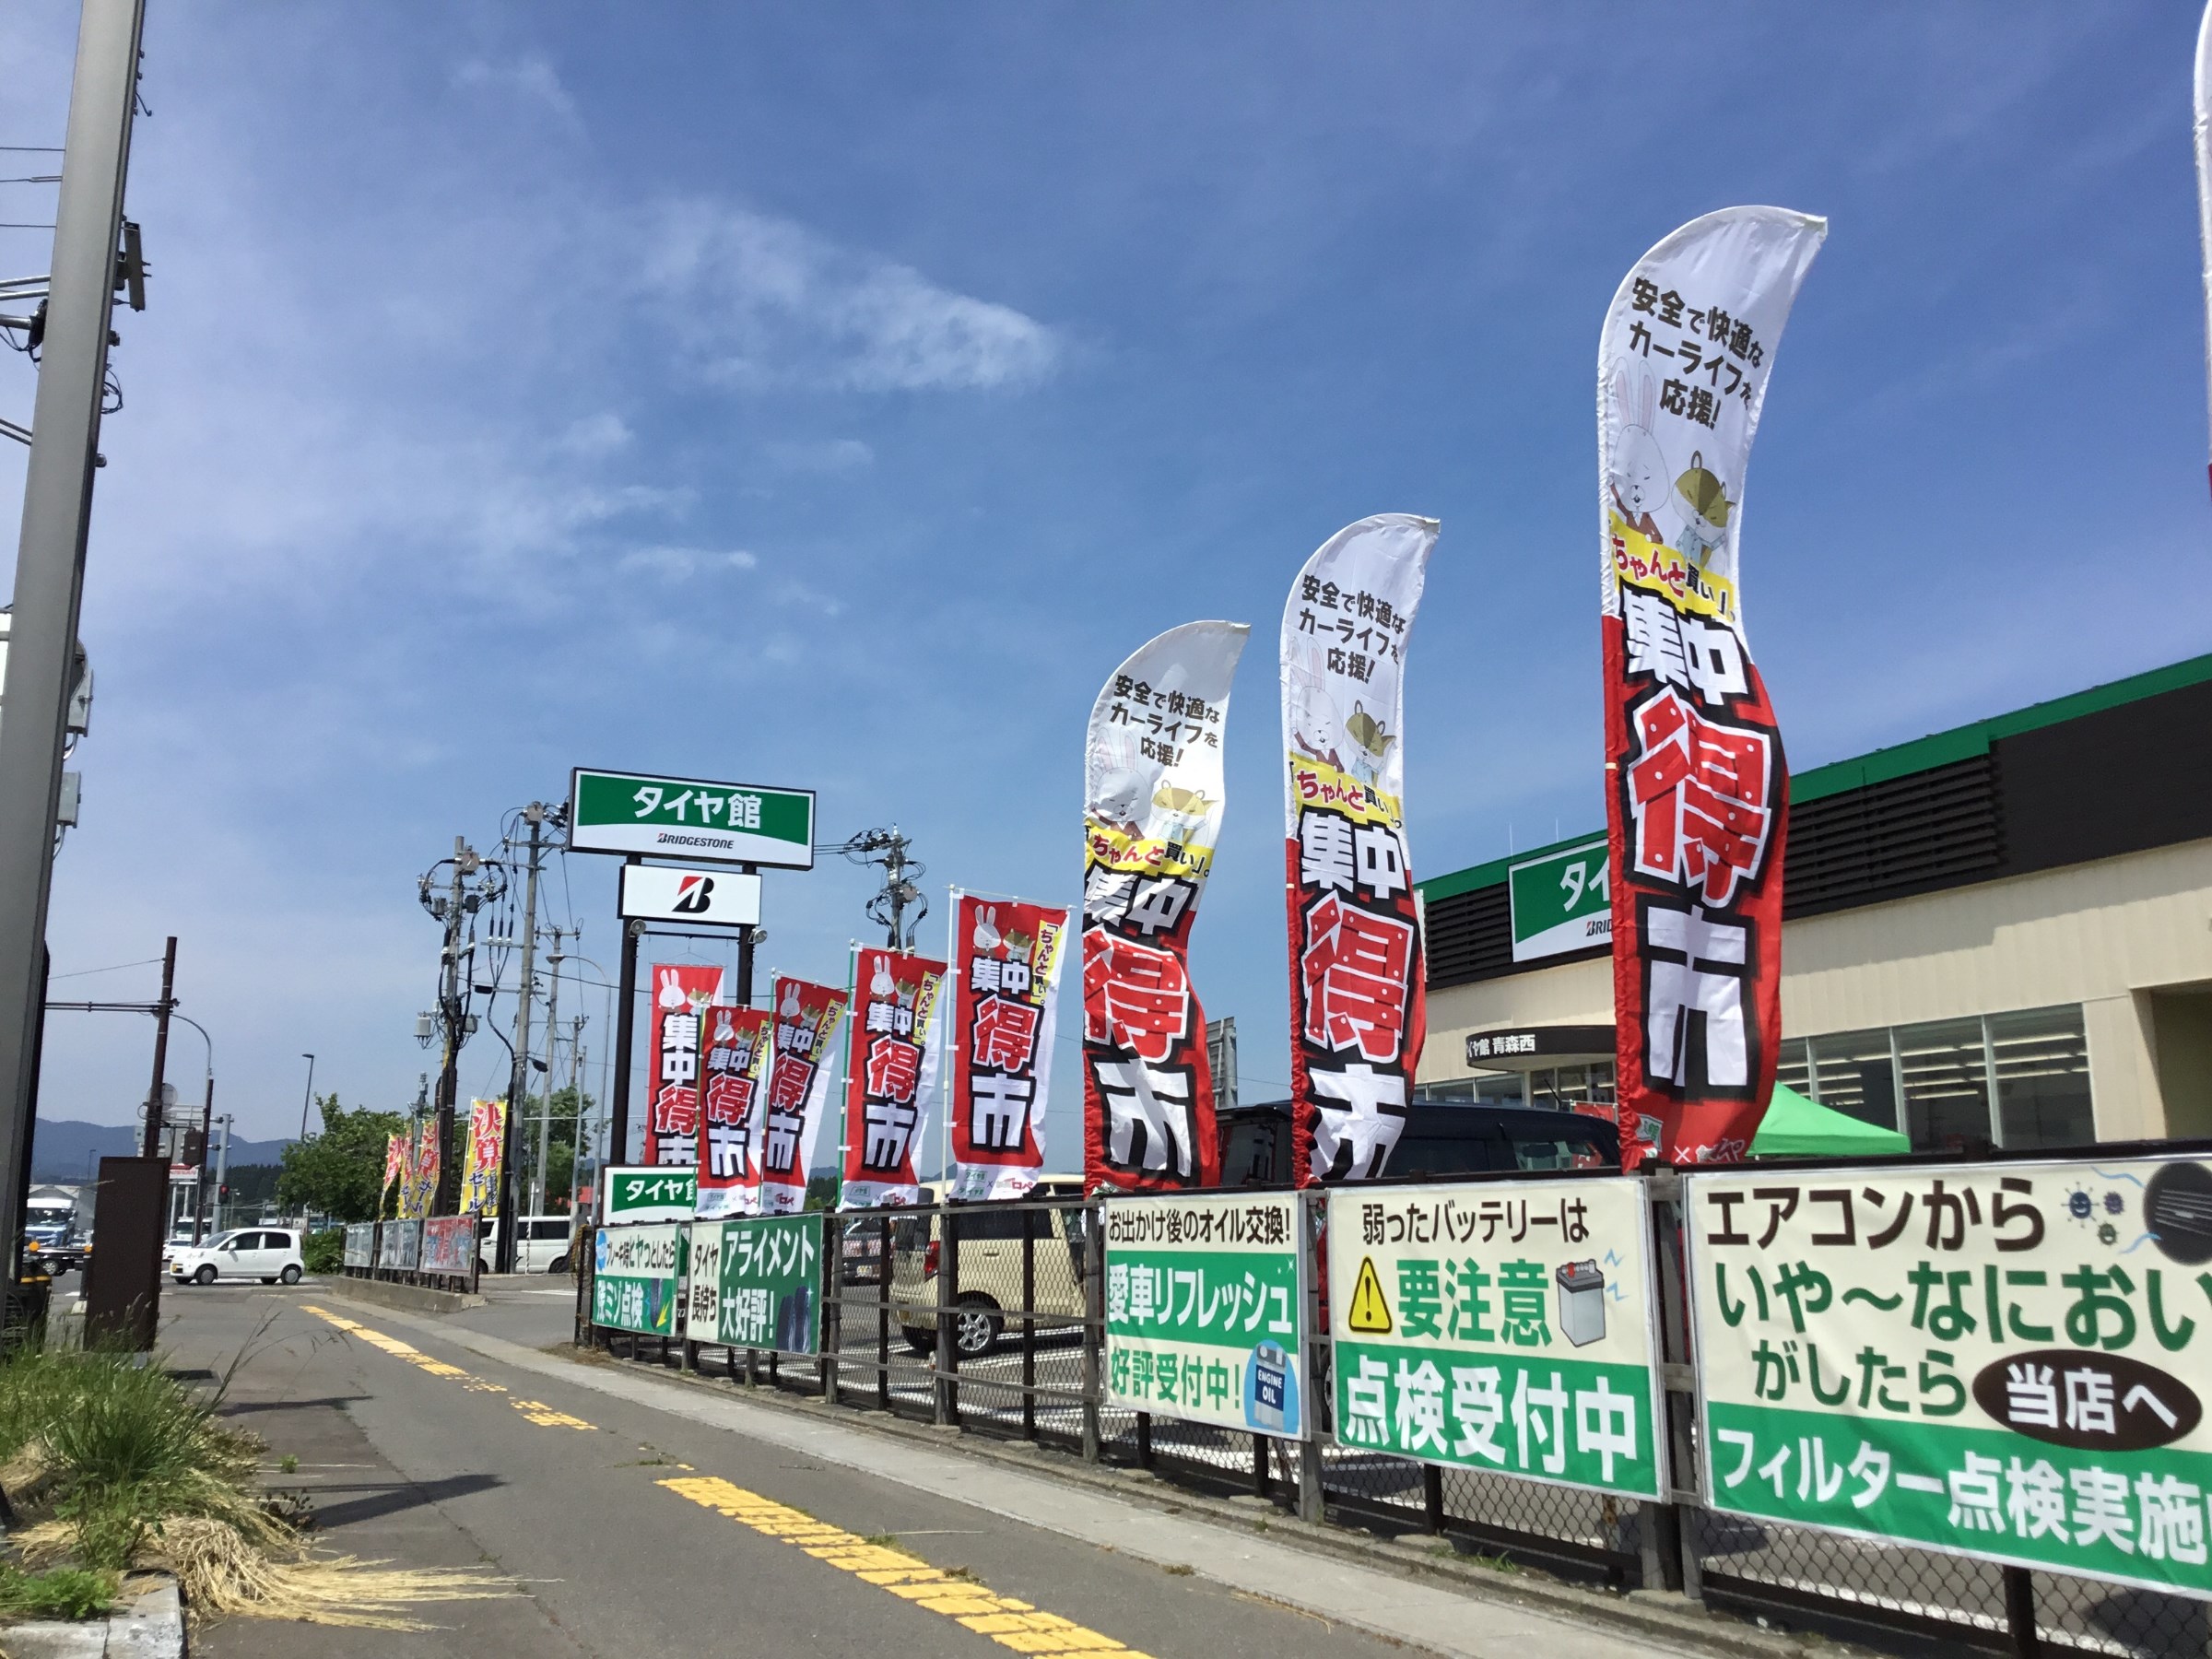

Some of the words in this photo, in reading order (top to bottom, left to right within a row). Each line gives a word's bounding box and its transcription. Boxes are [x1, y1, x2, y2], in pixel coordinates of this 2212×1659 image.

[1630, 276, 1765, 369] 安全で快適な
[1659, 378, 1720, 430] 応援!
[1301, 574, 1406, 634] 安全で快適な
[1327, 647, 1376, 684] 応援!
[1113, 675, 1220, 724] 安全で快適な
[1110, 702, 1218, 748] カーライフを
[1140, 736, 1184, 767] 応援!
[632, 785, 763, 829] タイヤ館
[656, 832, 735, 849] BRIDGESTONE
[1466, 1038, 1490, 1058] イヤ館
[1492, 1034, 1536, 1055] 青森西
[1109, 1206, 1290, 1245] お出かけ後のオイル交換!
[1361, 1197, 1590, 1245] 弱ったバッテリーは
[1707, 1177, 2046, 1253] エアコンから
[694, 1242, 719, 1277] タイヤ
[724, 1225, 816, 1278] アライメント
[691, 1284, 718, 1323] 長持ち
[722, 1287, 775, 1344] 大好評!
[1108, 1263, 1292, 1335] 愛車リフレッシュ
[1396, 1257, 1553, 1347] 要注意
[1111, 1347, 1240, 1412] 好評受付中!
[1257, 1370, 1283, 1389] ENGINE
[1262, 1386, 1277, 1405] OIL
[1752, 1339, 1968, 1418] がしたら
[2006, 1363, 2178, 1435] 当店へ
[1346, 1355, 1638, 1483] 点検受付中
[1717, 1429, 2212, 1565] フィルター点検実施
